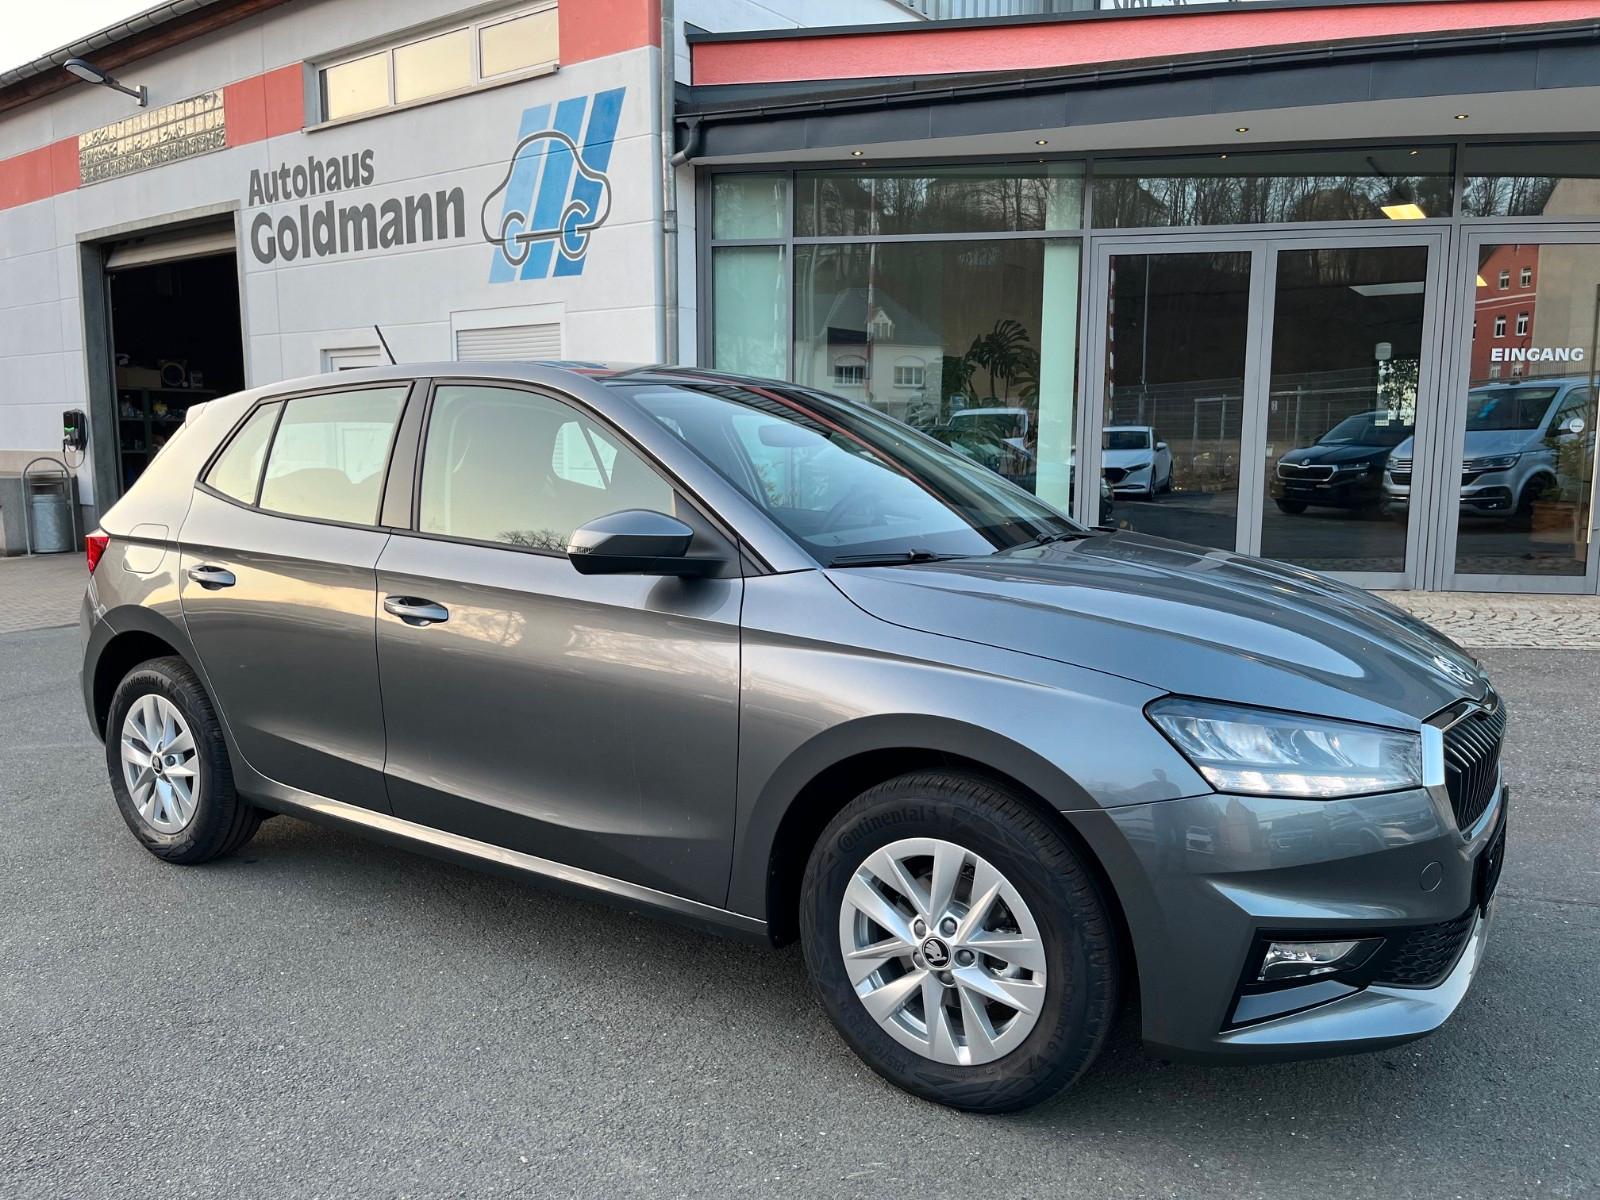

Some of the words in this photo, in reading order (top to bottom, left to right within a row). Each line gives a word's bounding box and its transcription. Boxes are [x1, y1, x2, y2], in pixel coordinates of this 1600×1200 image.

[249, 149, 375, 207] Autohaus
[250, 186, 466, 264] Goldmann
[1491, 347, 1584, 362] EINGANG
[837, 805, 924, 854] Continental
